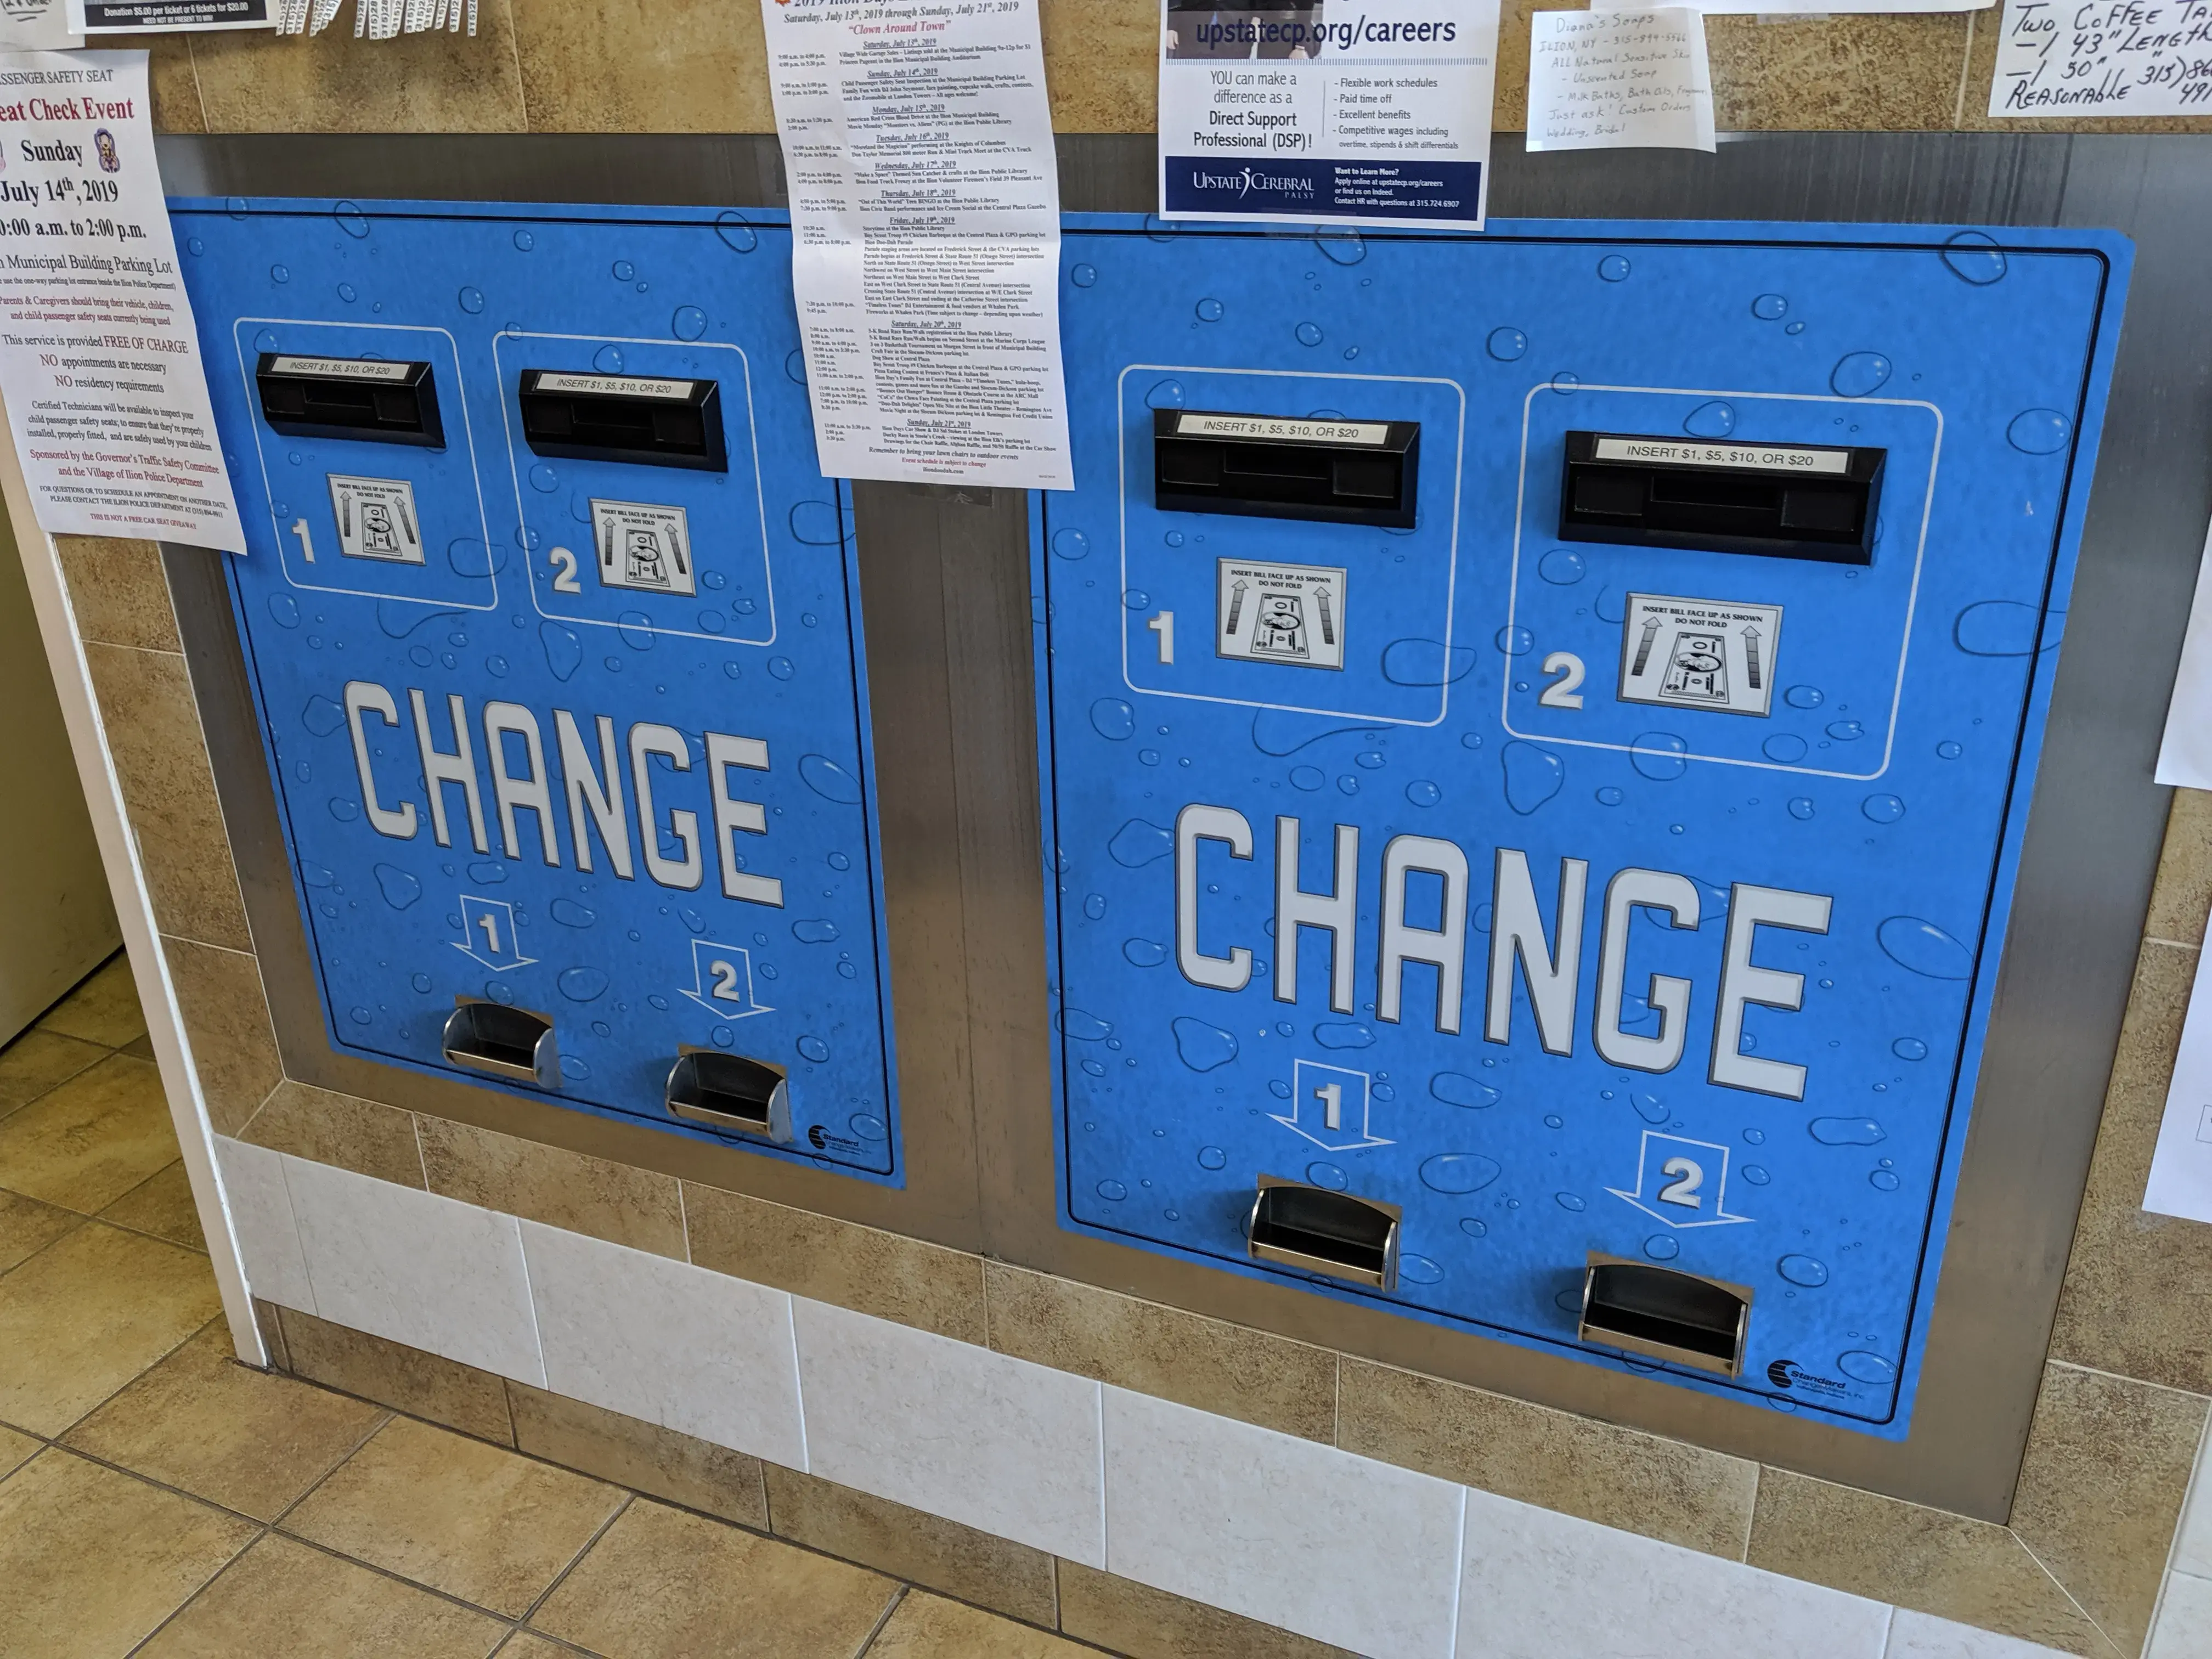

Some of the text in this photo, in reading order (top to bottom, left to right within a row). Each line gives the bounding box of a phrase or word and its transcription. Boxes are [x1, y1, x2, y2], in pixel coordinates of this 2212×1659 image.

[784, 13, 823, 24] Saturday,
[825, 12, 842, 22] July
[864, 9, 883, 19] 2019
[885, 8, 917, 19] through
[919, 6, 953, 17] Sunday,
[956, 4, 974, 16] July
[997, 1, 1019, 12] 2019
[883, 22, 917, 33] Around
[1197, 15, 1456, 50] upstatecp.org/careers
[1582, 40, 1597, 48] NY
[47, 70, 83, 83] SAFETY
[87, 69, 114, 82] SEAT
[1211, 70, 1297, 85] YOU can make a
[1340, 78, 1438, 87] Flexible work schedules
[1214, 89, 1293, 104] difference as a
[1340, 94, 1392, 103] Paid time off
[30, 98, 81, 120] Check
[82, 97, 134, 120] Event
[1339, 110, 1411, 119] Excellent benefits
[1210, 110, 1297, 130] Direct Support
[1194, 132, 1266, 147] Professional
[1339, 125, 1448, 137] Competitive wages including
[21, 139, 82, 167] Sunday
[1251, 173, 1314, 190] CEREBRAL
[1335, 177, 1351, 185] Apply
[1379, 179, 1443, 188] upstatecp.org/careers
[1, 180, 39, 207] July
[83, 180, 118, 202] 2019
[37, 223, 67, 236] a.m.
[71, 219, 83, 236] to
[86, 218, 114, 236] 2:00
[117, 224, 146, 242] p.m.
[5, 255, 67, 273] Municipal
[69, 255, 114, 274] Building
[115, 256, 154, 276] Parking
[153, 258, 173, 273] Lot
[2, 335, 189, 354] This service is provided FREE OF CHARGE
[40, 354, 58, 366] NO
[61, 357, 117, 369] appointments
[131, 363, 166, 375] necessary
[375, 366, 390, 375] $20
[54, 375, 164, 393] NO residency requirements
[557, 379, 590, 388] INSERT
[640, 384, 654, 392] OR
[655, 385, 672, 393] $20
[1204, 421, 1248, 431] INSERT
[1316, 427, 1334, 437] OR
[1338, 428, 1358, 438] $20
[1627, 445, 1679, 458] INSERT
[1763, 454, 1784, 464] OR
[1788, 454, 1814, 466] $20
[292, 518, 315, 564] 1
[549, 546, 581, 595] 2
[1732, 614, 1763, 622] SHOWN
[1148, 611, 1173, 665] 1
[1538, 651, 1585, 709] 2
[343, 680, 785, 908] CHANGE
[478, 914, 500, 953] 1
[1175, 802, 1833, 1102] CHANGE
[709, 960, 741, 1002] 2
[1314, 1081, 1342, 1131] 1
[822, 1133, 859, 1147] Standard
[1658, 1157, 1704, 1207] 2
[1791, 1370, 1846, 1389] Standard
